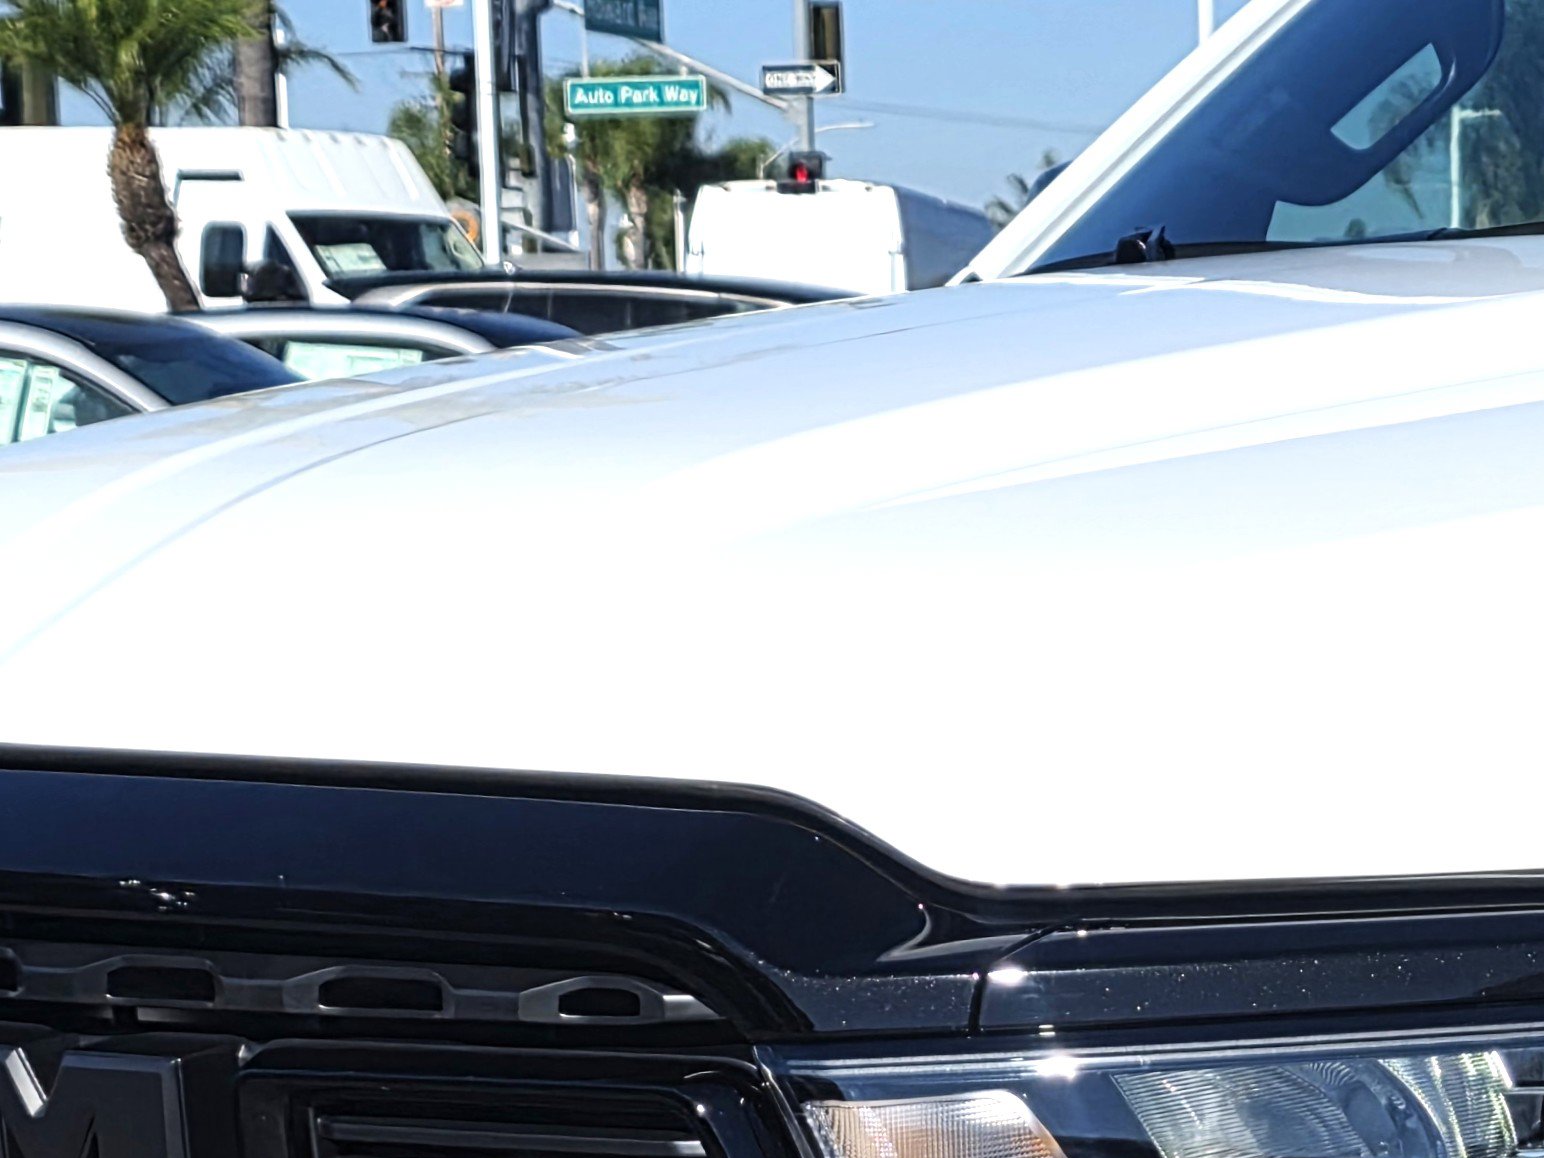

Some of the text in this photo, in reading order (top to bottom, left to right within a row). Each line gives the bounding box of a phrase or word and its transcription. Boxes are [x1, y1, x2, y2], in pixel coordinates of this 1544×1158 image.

[574, 84, 698, 105] Auto Park Way
